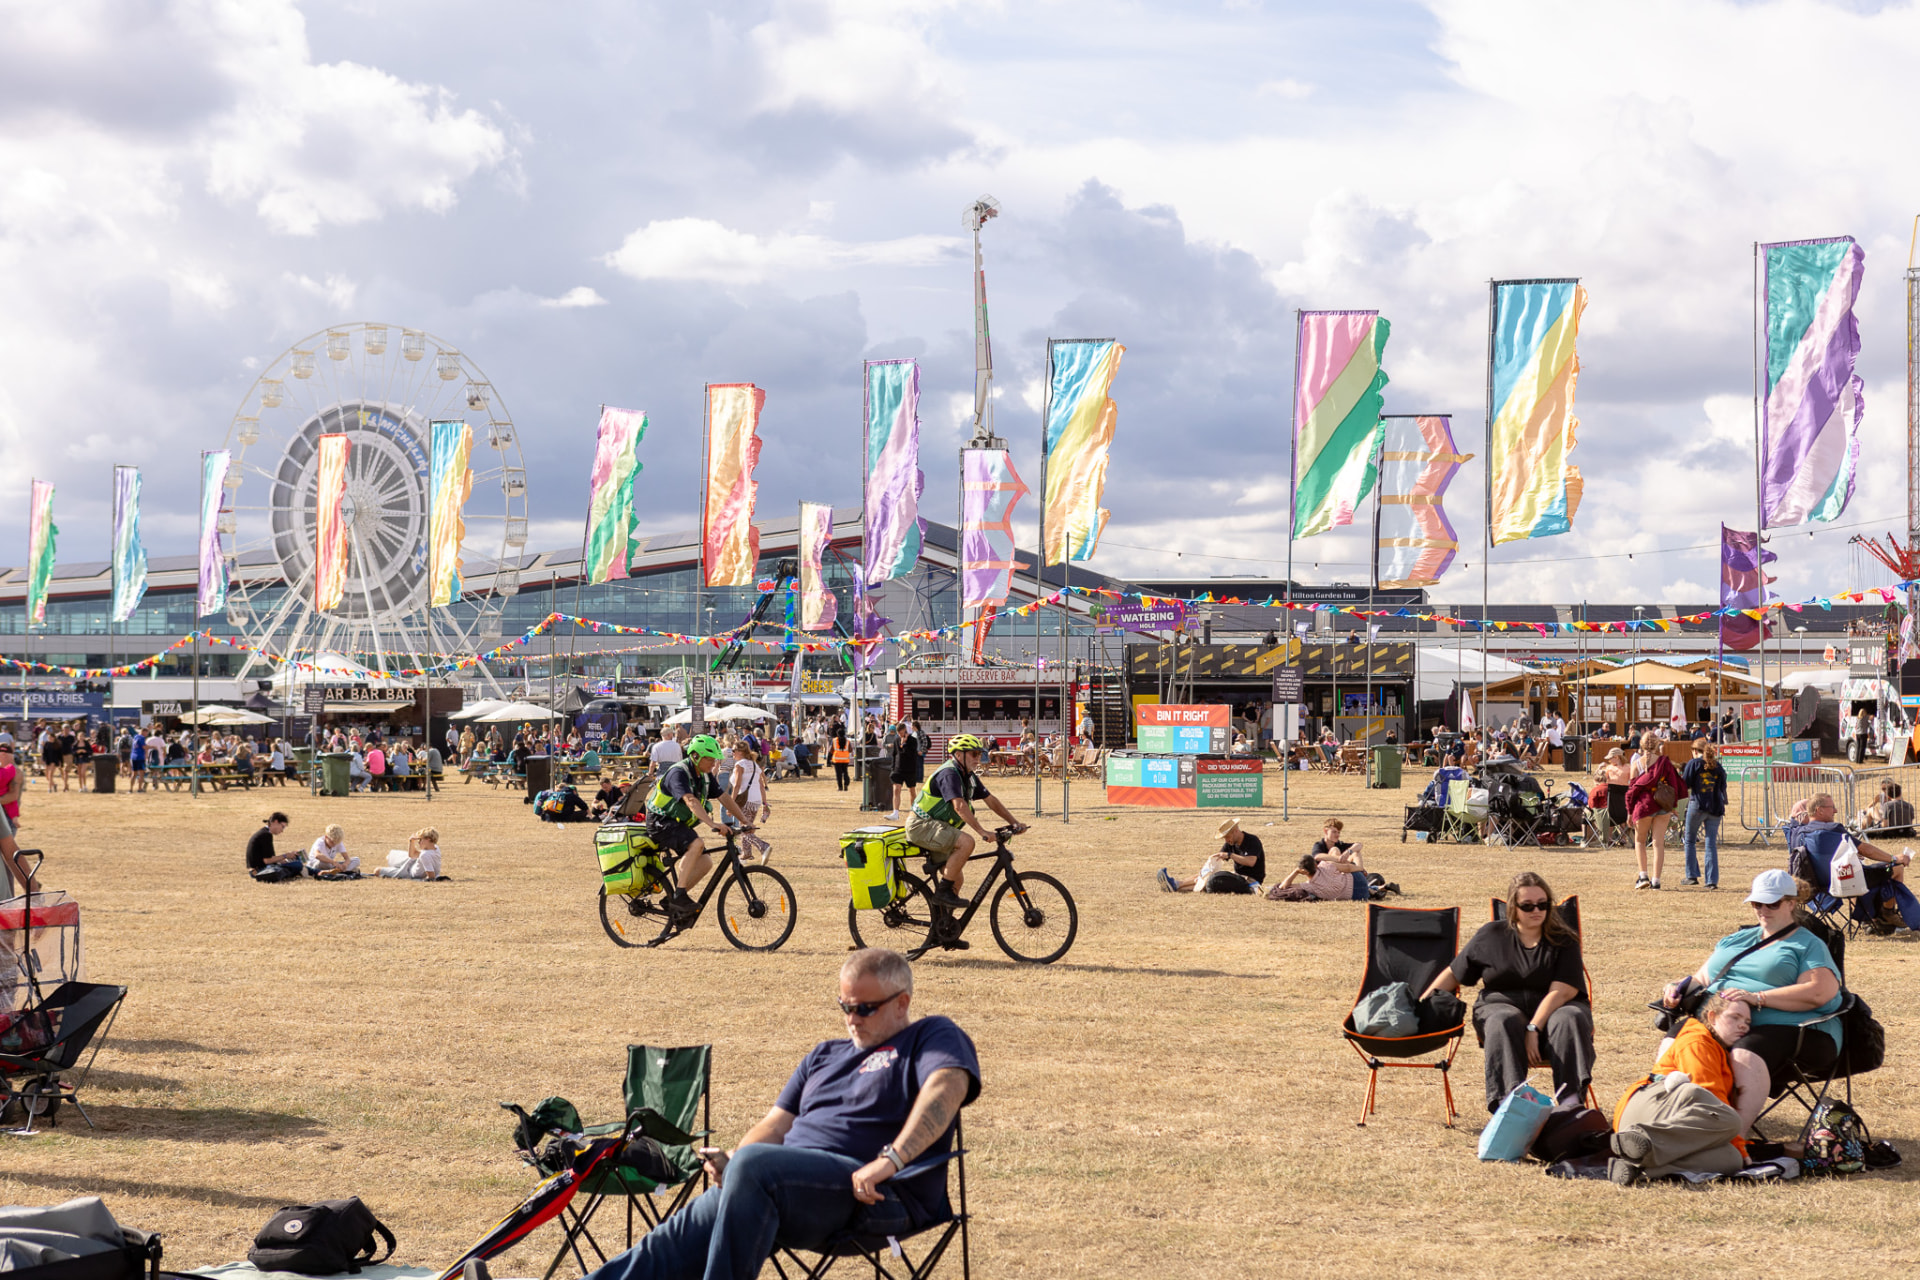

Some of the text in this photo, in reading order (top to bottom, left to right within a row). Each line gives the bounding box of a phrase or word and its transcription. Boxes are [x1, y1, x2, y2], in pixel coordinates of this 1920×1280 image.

[381, 419, 427, 471] MICHELIN
[1121, 612, 1175, 622] WATERING
[802, 669, 811, 680] AC
[959, 671, 1016, 681] SELF SERVE BAR
[802, 680, 834, 693] CHEESE
[2, 693, 84, 703] CHICKEN & FRIES
[325, 688, 415, 700] AR BAR BAR
[153, 703, 183, 714] PIZZA
[1767, 704, 1782, 714] RIGHT
[1157, 711, 1209, 721] BIN IT RIGHT
